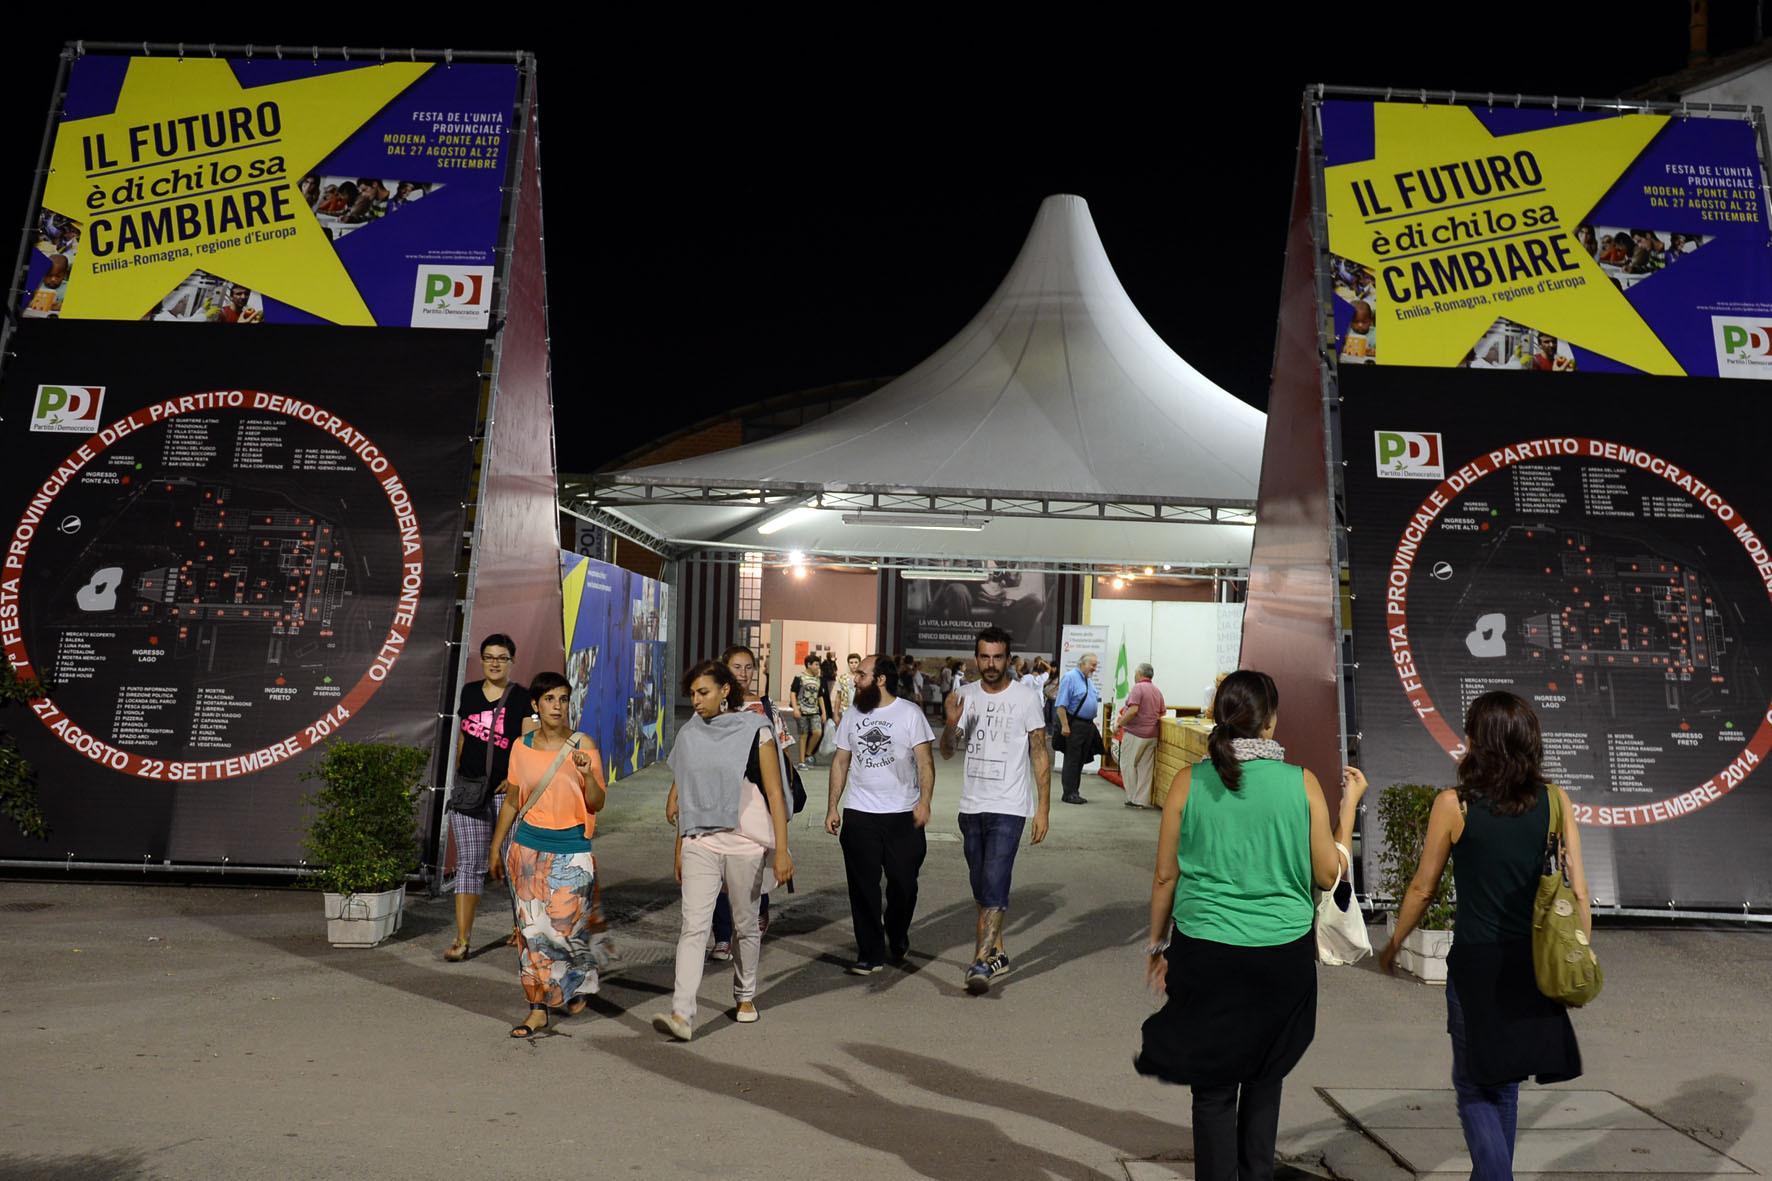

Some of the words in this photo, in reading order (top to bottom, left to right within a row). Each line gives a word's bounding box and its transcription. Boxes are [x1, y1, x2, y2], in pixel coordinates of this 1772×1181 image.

[412, 112, 443, 121] FESTA
[447, 112, 460, 122] DE
[464, 111, 502, 122] L'UNITÀ
[432, 124, 501, 134] PROVINCIALE
[82, 133, 118, 171] IL
[128, 101, 282, 162] FUTURO
[384, 134, 426, 143] MODENA
[438, 135, 472, 145] PONTE
[475, 135, 500, 145] ALTO
[387, 146, 406, 155] DAL
[410, 146, 423, 155] 27
[426, 146, 467, 156] AGOSTO
[470, 147, 482, 156] AL
[486, 147, 499, 157] 22
[437, 158, 497, 168] SETTEMBRE
[1666, 164, 1695, 175] FESTA
[1699, 166, 1711, 175] DE
[1715, 166, 1753, 177] L'UNITÀ
[86, 184, 106, 209] è
[112, 176, 145, 204] di
[151, 165, 204, 197] chi
[210, 162, 242, 185] lo
[249, 156, 286, 178] sa
[1351, 179, 1392, 217] IL
[1394, 150, 1543, 209] FUTURO
[1644, 186, 1685, 197] MODENA
[1696, 188, 1728, 198] PONTE
[1732, 190, 1756, 199] ALTO
[1688, 176, 1754, 189] PROVINCIALE
[90, 184, 295, 257] CAMBIARE
[1650, 197, 1669, 208] DAL
[1673, 198, 1684, 208] 27
[1688, 199, 1727, 210] AGOSTO
[1730, 201, 1742, 210] AL
[1746, 202, 1757, 211] 22
[1701, 211, 1759, 223] SETTEMBRE
[1372, 230, 1390, 255] è
[1396, 223, 1428, 251] di
[1432, 212, 1482, 244] chi
[1483, 210, 1516, 233] lo
[1522, 205, 1559, 227] sa
[92, 247, 193, 274] Emilia-Romagna,
[196, 235, 241, 253] regione
[244, 226, 296, 245] d'Europa
[1382, 234, 1580, 303] CAMBIARE
[424, 274, 483, 305] PD
[1395, 293, 1491, 320] Emilia-Romagna,
[1492, 284, 1535, 303] regione
[1536, 274, 1586, 293] d'Europa
[36, 386, 101, 420] PD
[148, 390, 244, 421] PARTITO
[98, 415, 144, 446] DEL
[252, 392, 388, 474] DEMOCRATICO
[1378, 432, 1440, 466] PD
[1489, 438, 1579, 468] PARTITO
[1446, 462, 1489, 493] DEL
[1590, 440, 1735, 521] DEMOCRATICO
[6, 443, 96, 569] PROVINCIALE
[382, 475, 420, 556] MODENA
[1387, 490, 1449, 615] PROVINCIALE
[394, 562, 422, 627] PONTE
[0, 577, 22, 648] FESTA
[368, 629, 405, 681] ALTO
[1390, 623, 1422, 692] FESTA
[986, 715, 1014, 728] THE
[987, 701, 1016, 714] DAY
[32, 698, 59, 719] 27
[50, 718, 129, 770] AGOSTO
[137, 759, 164, 778] 22
[167, 736, 302, 780] SETTEMBRE
[305, 704, 350, 745] 2014
[967, 743, 981, 754] OF
[1449, 744, 1466, 760] 2
[1572, 804, 1592, 823] 22
[1599, 780, 1722, 825] SETTEMBRE
[1720, 748, 1759, 788] 2014
